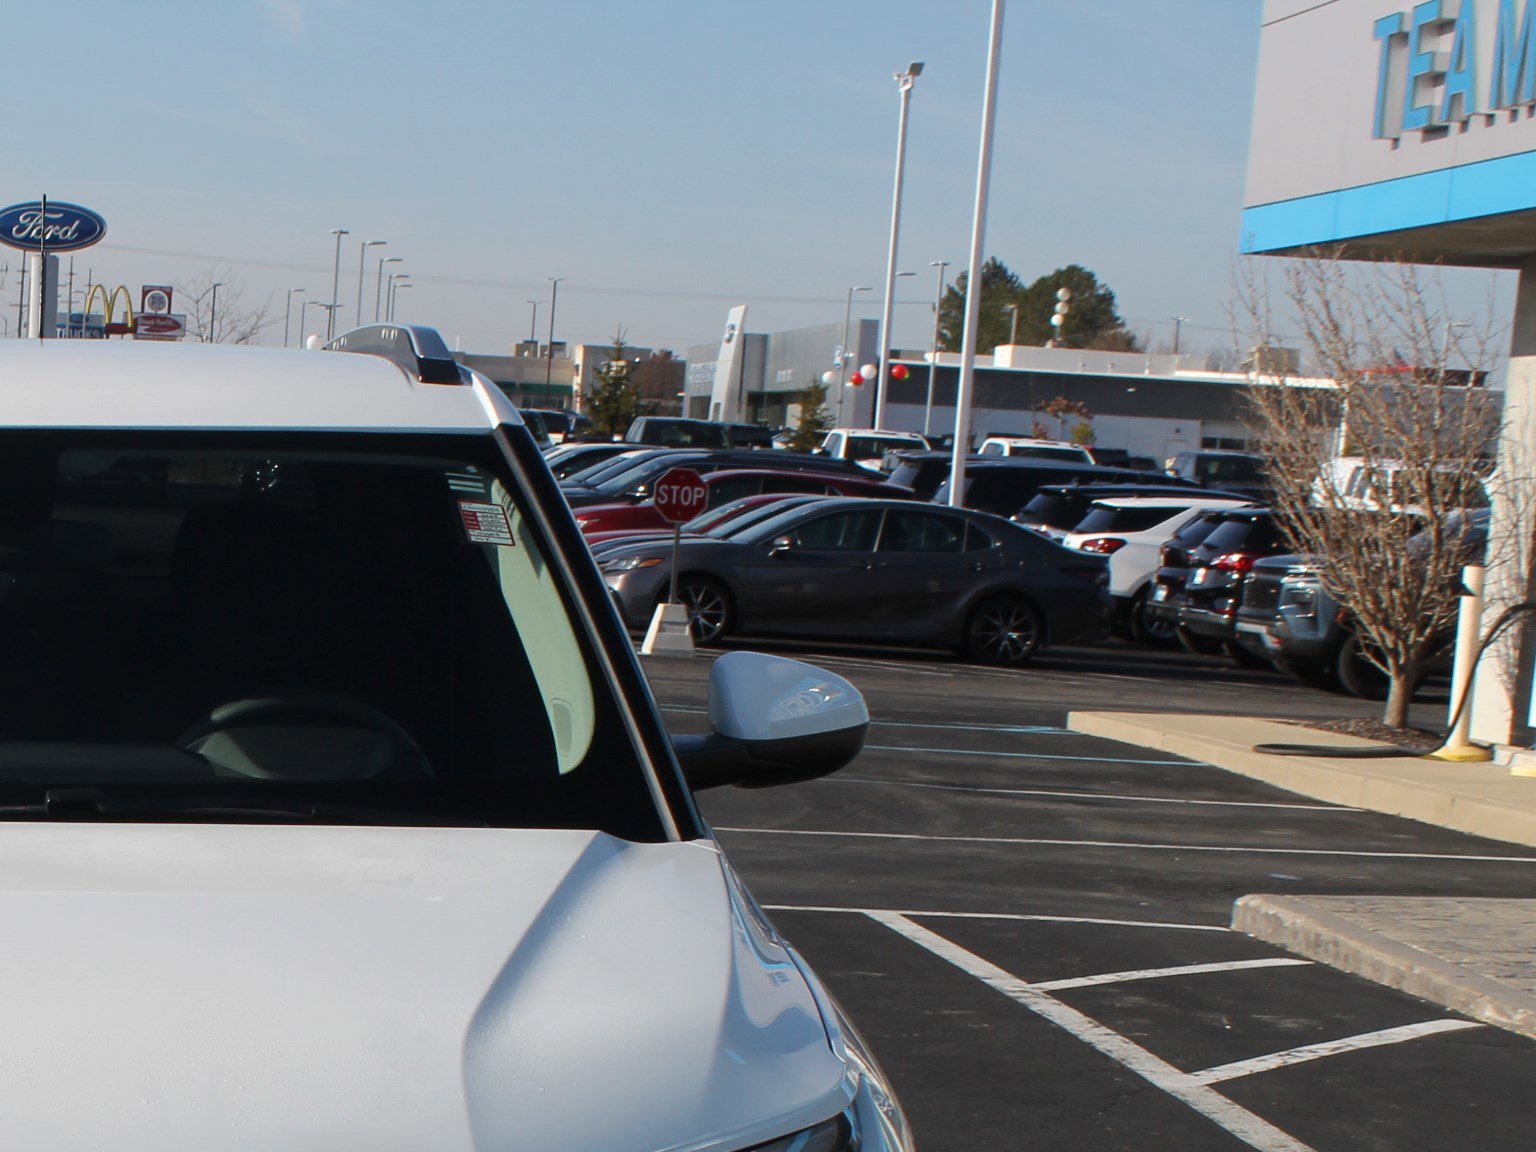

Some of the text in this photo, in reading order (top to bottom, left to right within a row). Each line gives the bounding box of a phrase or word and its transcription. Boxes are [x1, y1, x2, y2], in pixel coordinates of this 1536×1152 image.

[1372, 0, 1536, 139] TEAM
[12, 211, 81, 240] Ford
[657, 485, 705, 506] STOP
